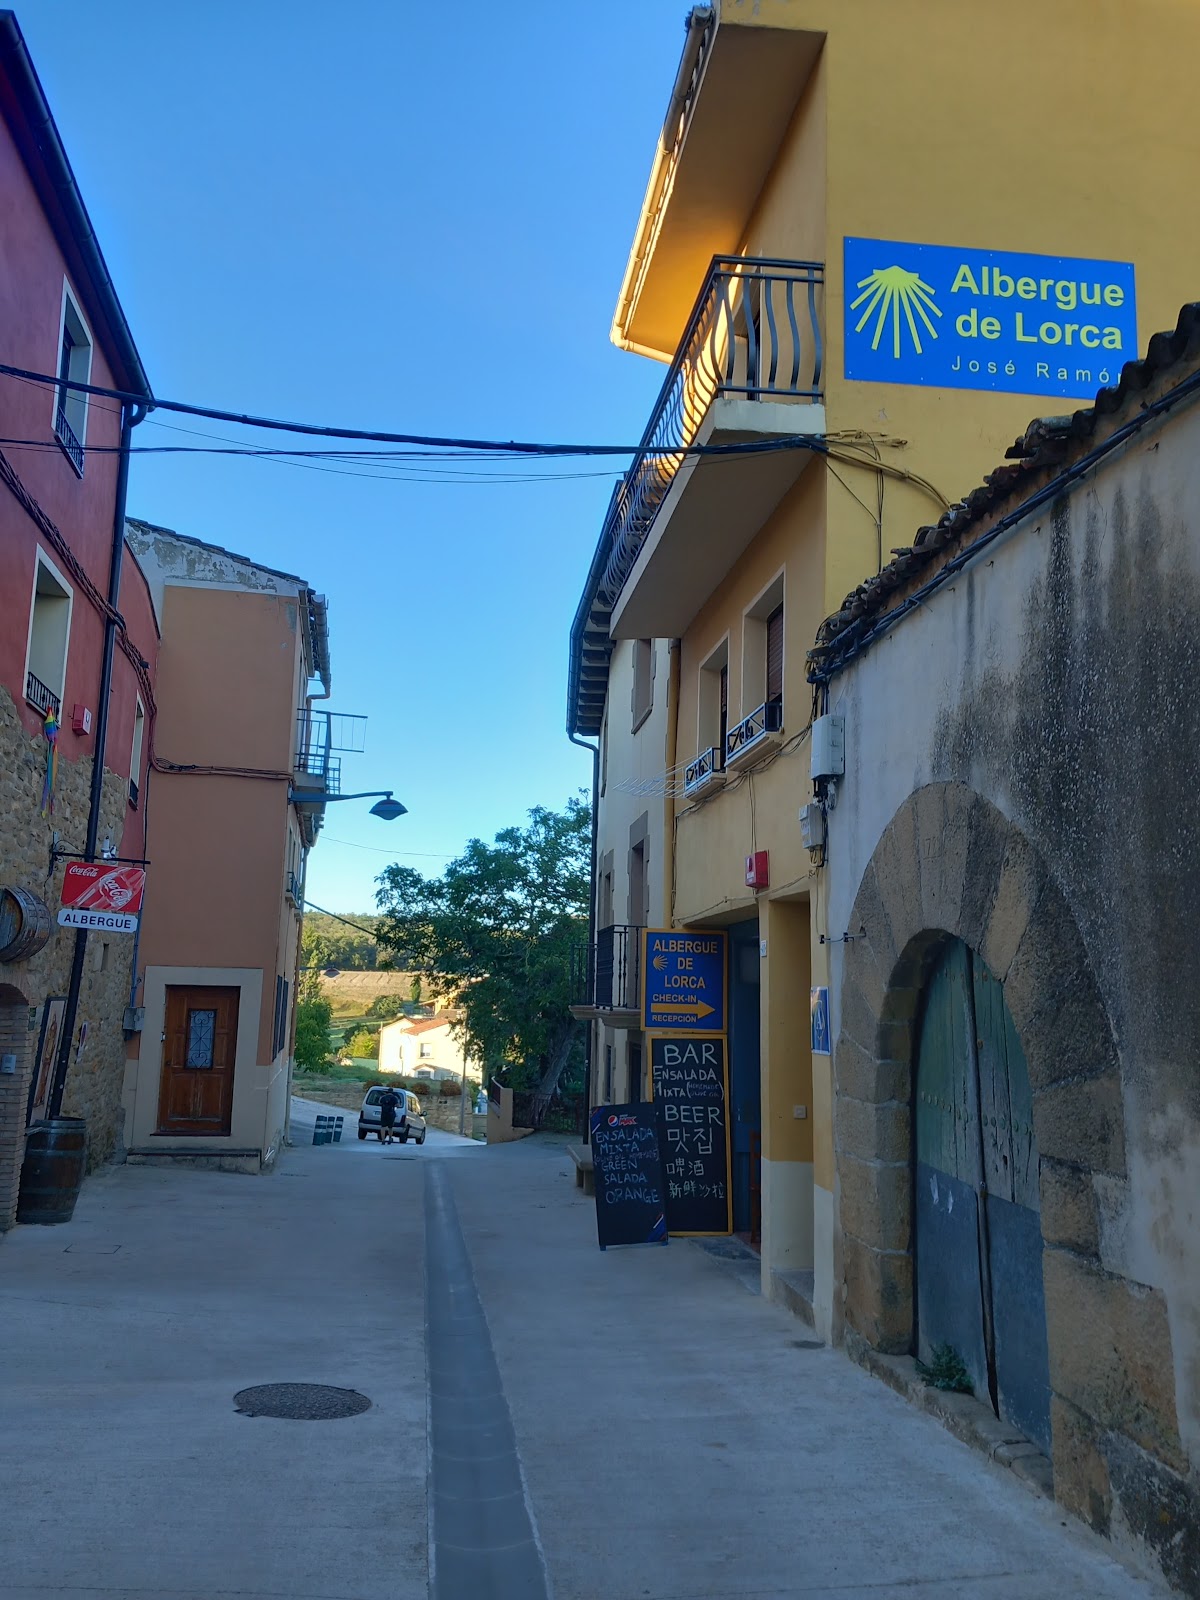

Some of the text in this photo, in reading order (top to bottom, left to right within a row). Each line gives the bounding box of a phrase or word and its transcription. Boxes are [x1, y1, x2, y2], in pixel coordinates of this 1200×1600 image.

[950, 264, 1124, 310] Albergue
[955, 308, 1123, 350] de Lorca
[951, 355, 1016, 375] José
[64, 913, 132, 929] ALBERGUE
[653, 939, 718, 953] ALBERGUE
[677, 957, 694, 970] DE
[664, 975, 706, 989] LORCA
[652, 993, 697, 1003] CHECK-IN
[651, 1014, 697, 1023] RECEPCIÓN
[664, 1043, 718, 1065] BAR
[653, 1065, 717, 1081] ENSALADA
[664, 1104, 724, 1126] BEER
[595, 1127, 654, 1143] ENSALADA
[667, 1127, 713, 1154] 맛집
[600, 1141, 640, 1155] MIXTA
[601, 1158, 638, 1172] GREEN
[666, 1157, 705, 1177] 啤酒
[604, 1171, 648, 1185] SALADA
[605, 1186, 660, 1204] ORANGE
